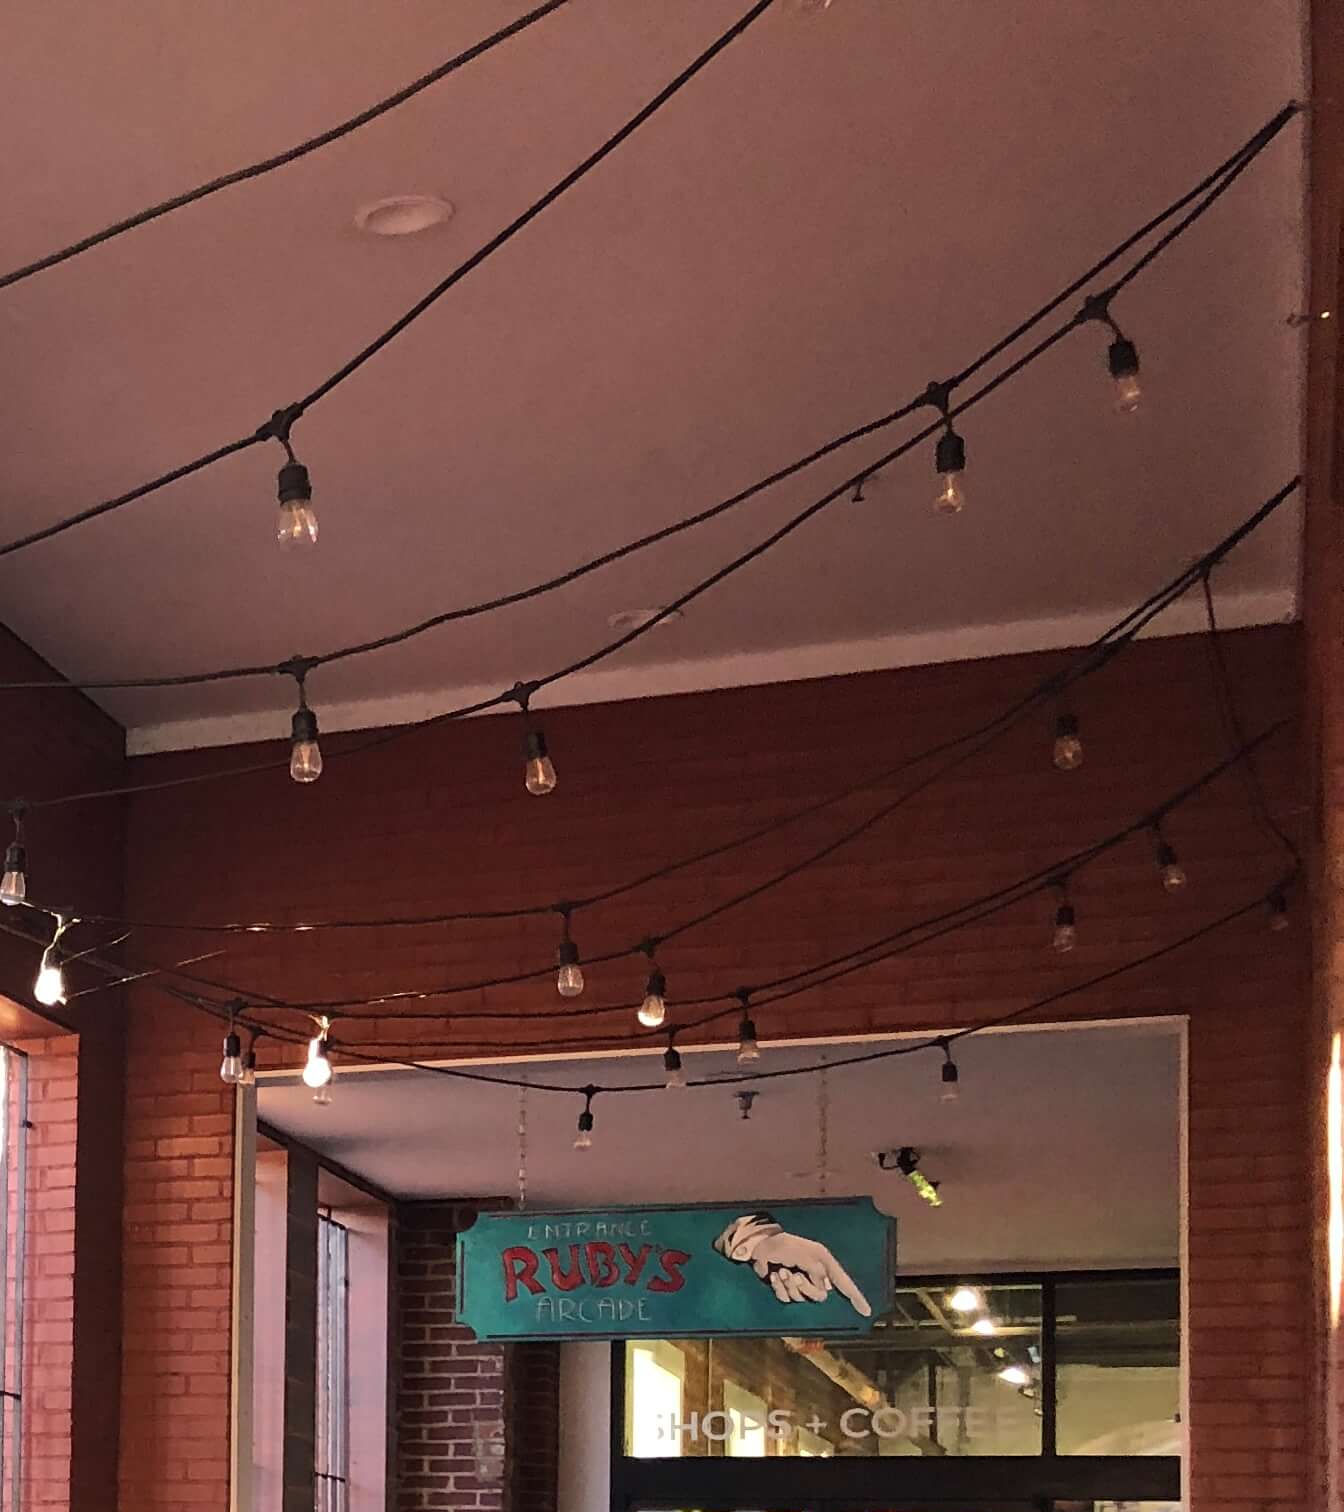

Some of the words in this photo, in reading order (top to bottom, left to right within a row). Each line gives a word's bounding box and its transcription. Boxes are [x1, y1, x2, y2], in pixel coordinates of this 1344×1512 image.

[526, 1219, 653, 1240] ENTRANCE
[502, 1241, 693, 1303] RUBY'S
[535, 1295, 653, 1324] ARCADE
[656, 1408, 793, 1442] SHOPS
